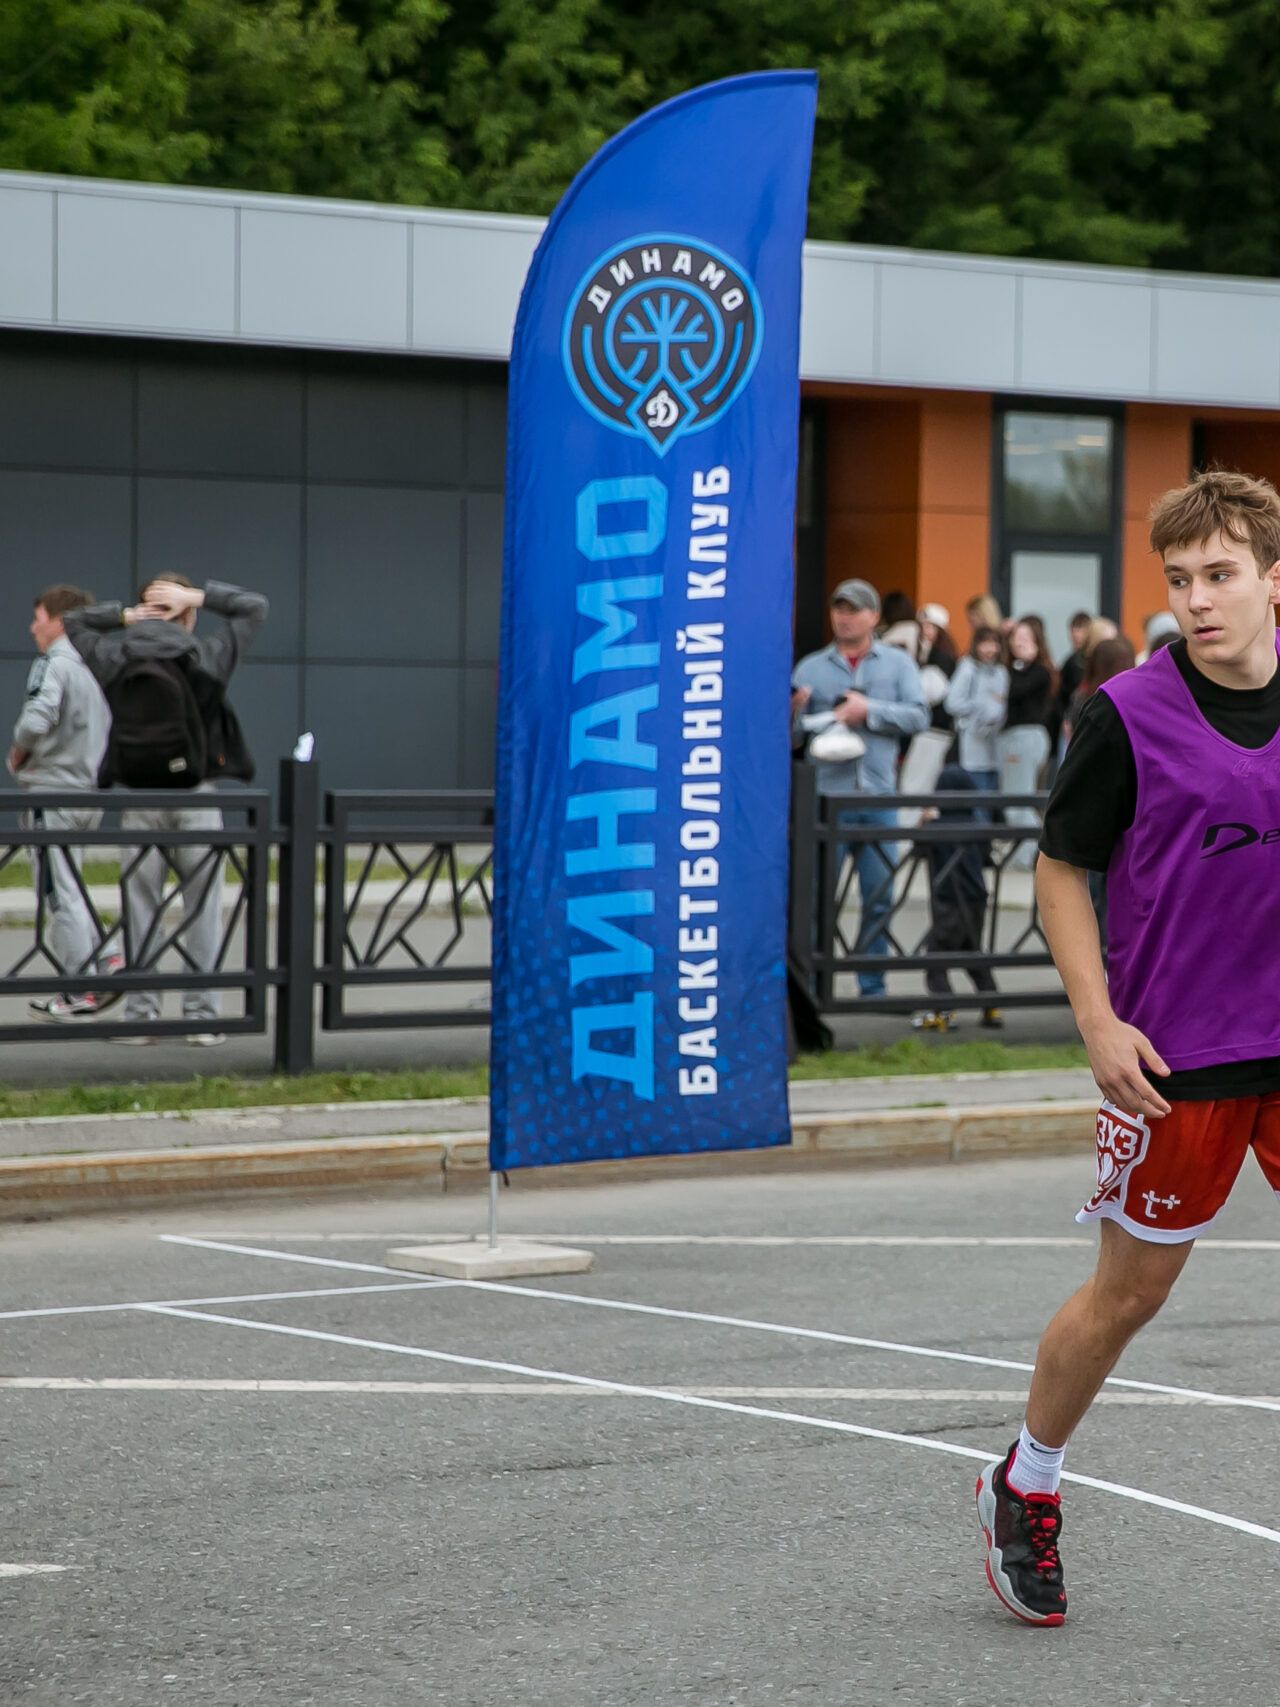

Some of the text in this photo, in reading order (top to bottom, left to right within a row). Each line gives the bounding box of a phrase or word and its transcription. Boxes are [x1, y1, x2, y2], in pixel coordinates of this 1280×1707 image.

[586, 248, 745, 314] ДИНАМО
[565, 475, 668, 1101] ДИНАМО
[676, 464, 731, 1096] БАСКЕТБОЛЬНЫЙ КЛУБ
